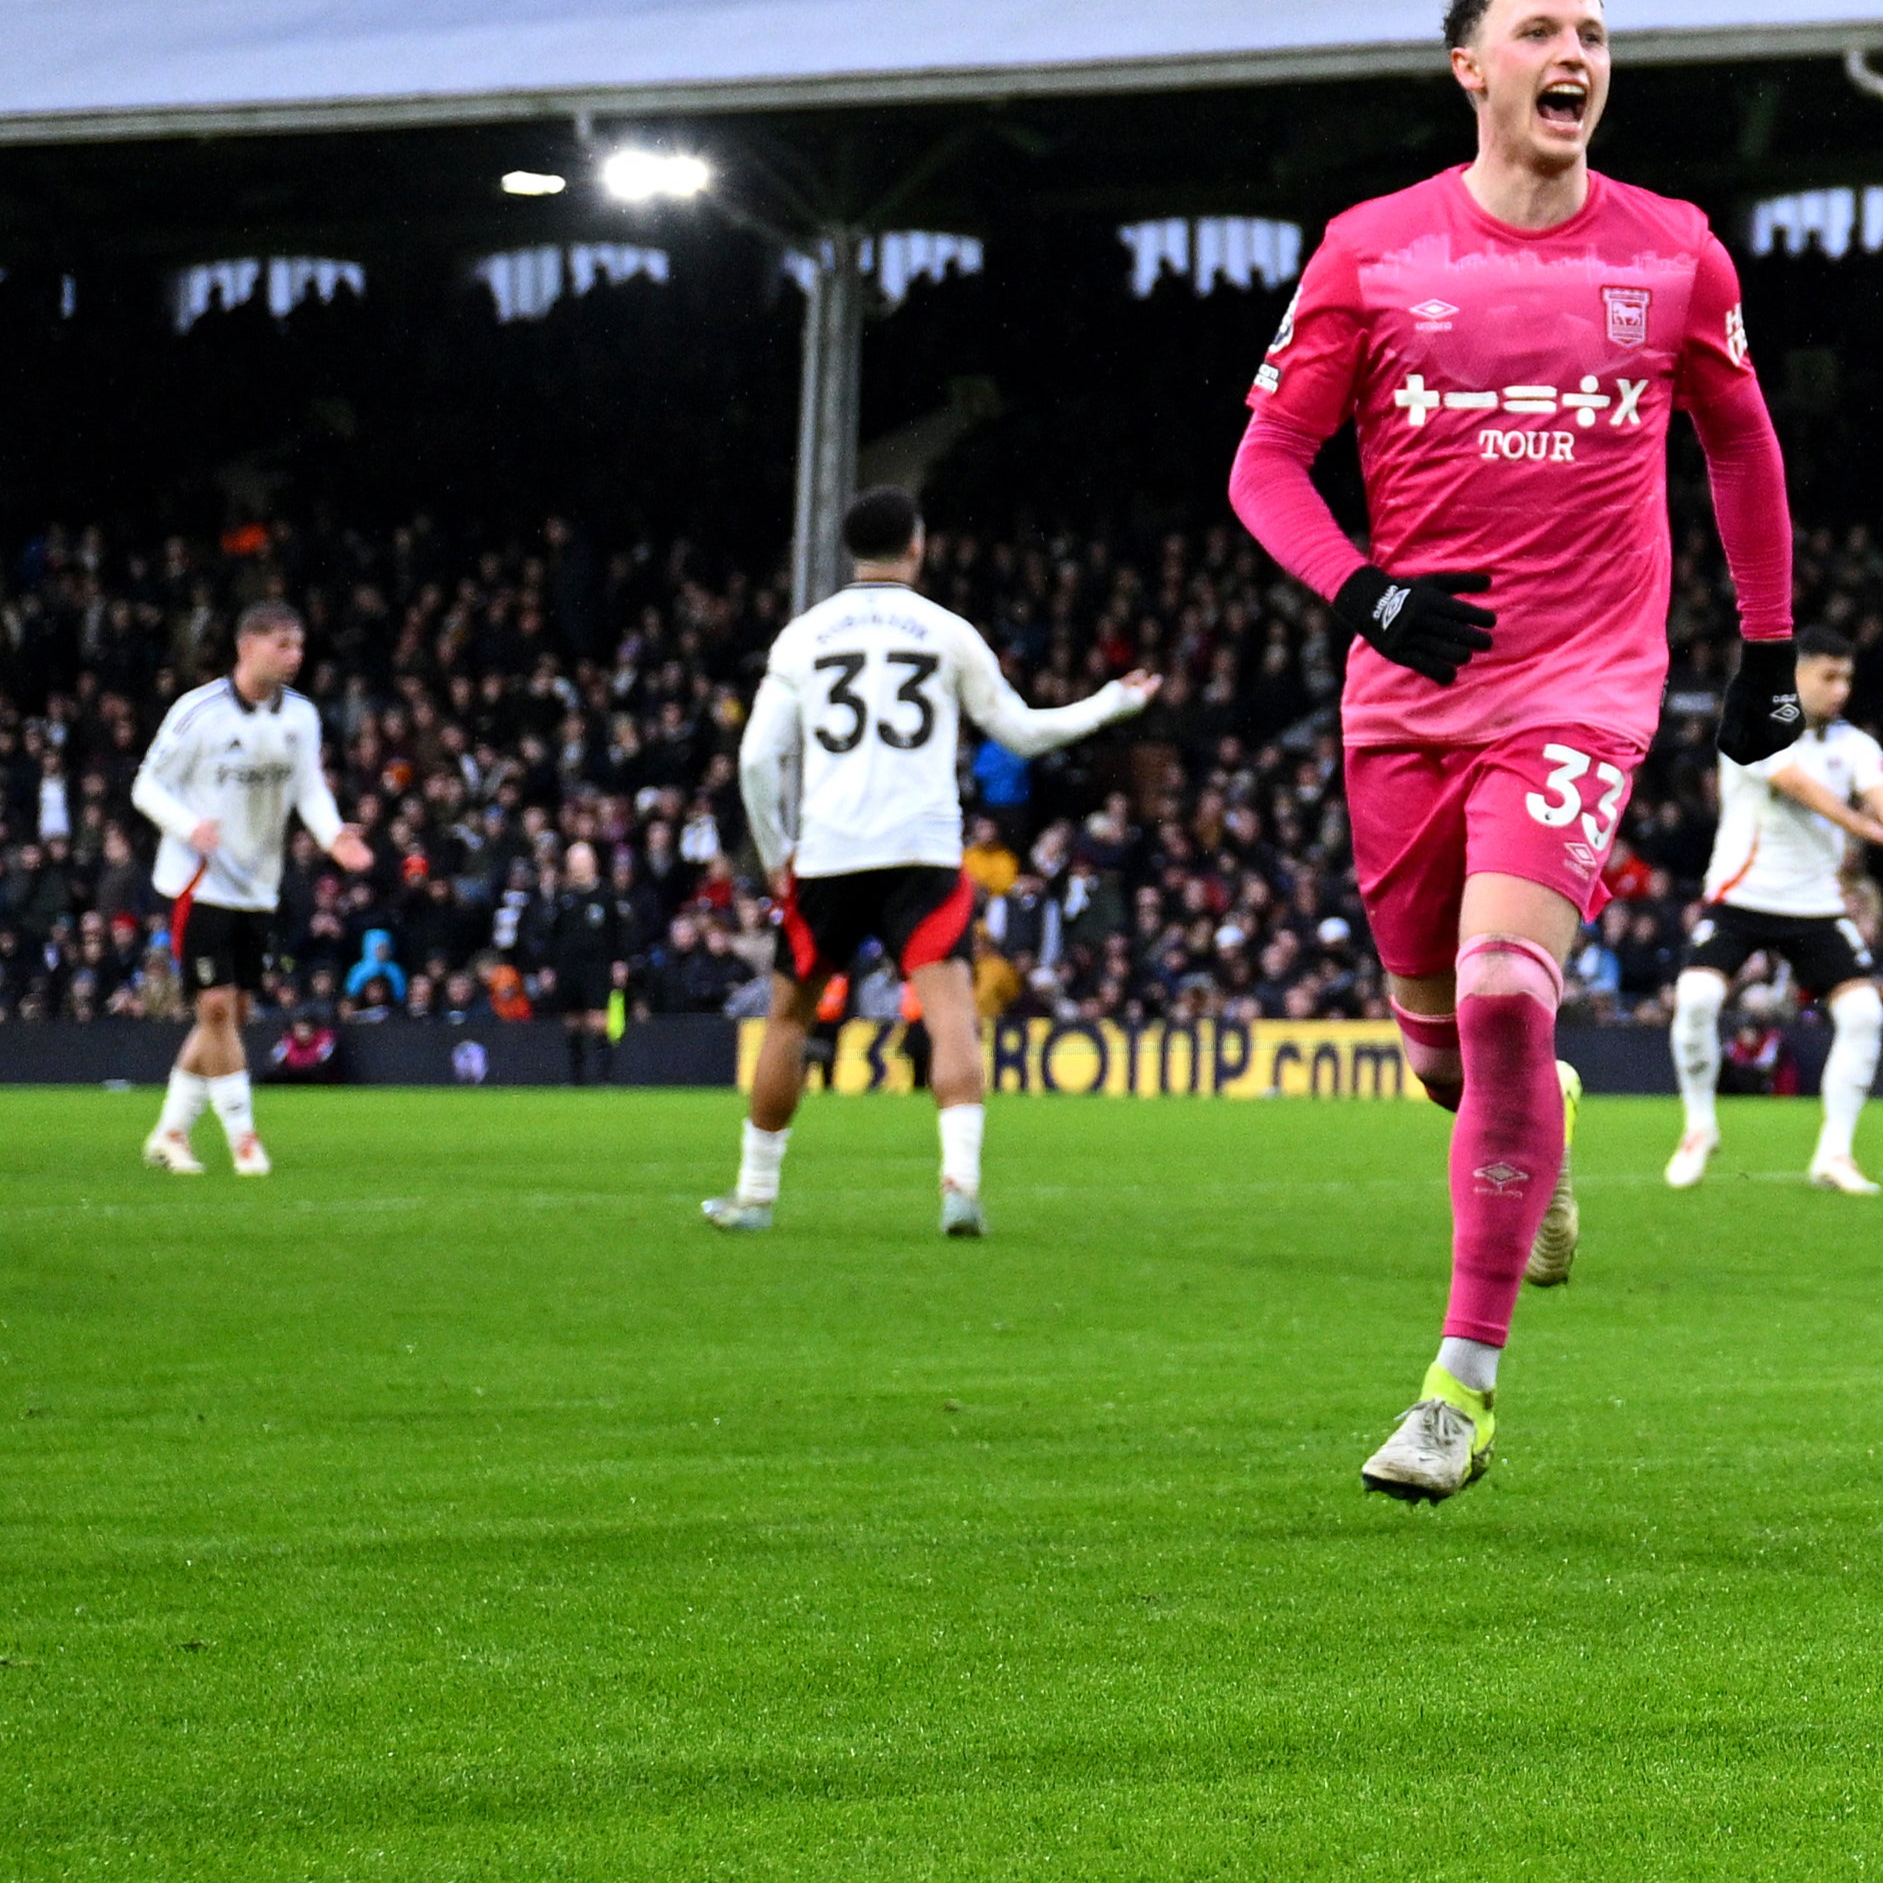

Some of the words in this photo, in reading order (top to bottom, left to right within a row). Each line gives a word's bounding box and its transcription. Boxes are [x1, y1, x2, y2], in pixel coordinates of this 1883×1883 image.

[1478, 429, 1576, 463] TOUR
[813, 651, 940, 754] 33
[1525, 743, 1627, 852] 33
